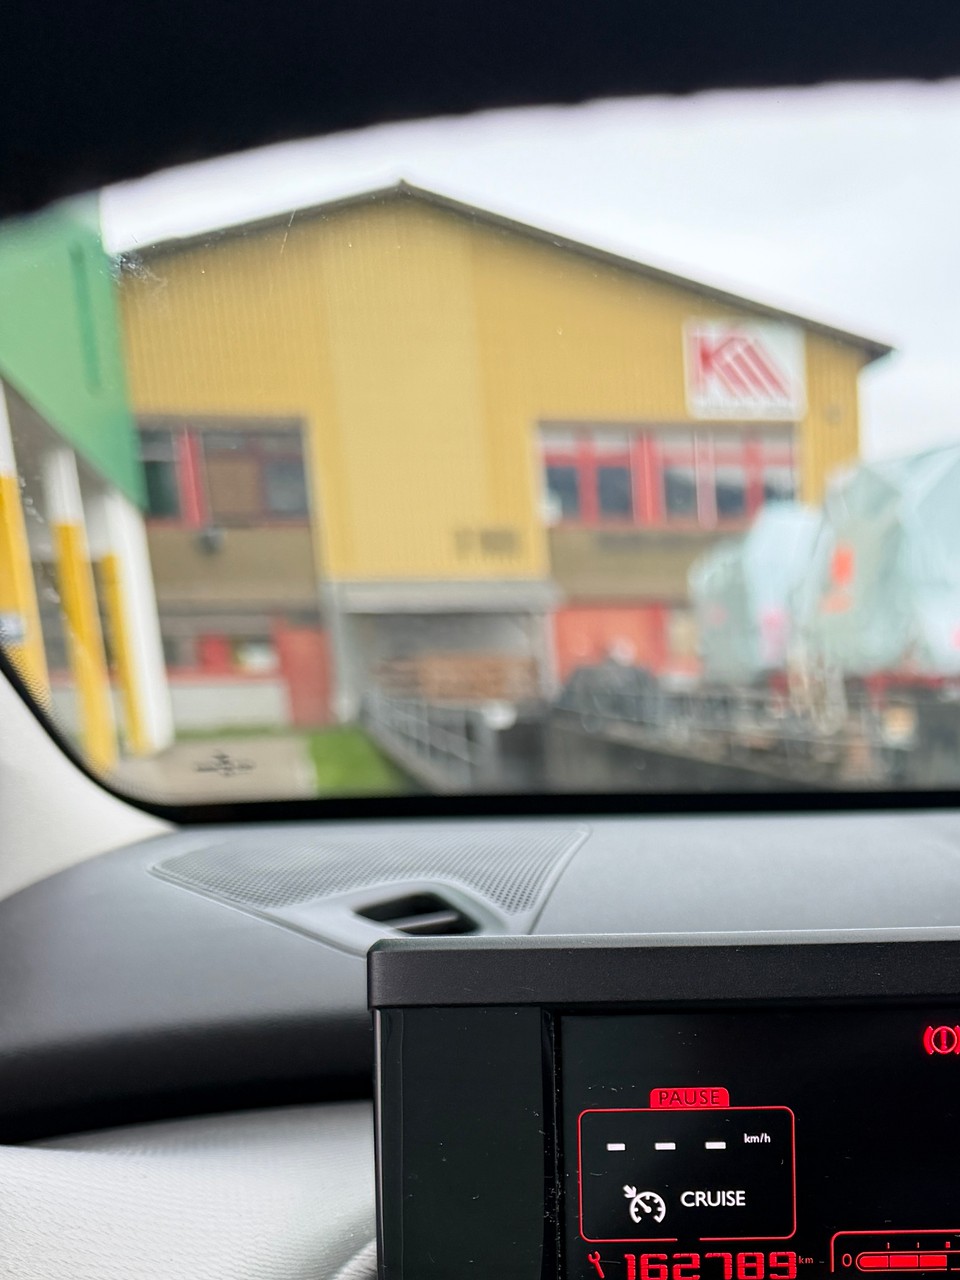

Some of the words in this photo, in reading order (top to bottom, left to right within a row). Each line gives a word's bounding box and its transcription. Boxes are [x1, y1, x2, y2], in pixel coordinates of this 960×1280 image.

[657, 1089, 721, 1106] PAUSE
[743, 1132, 772, 1144] km/h
[680, 1190, 746, 1208] CRUISE
[798, 1255, 814, 1265] km
[841, 1253, 853, 1268] 0
